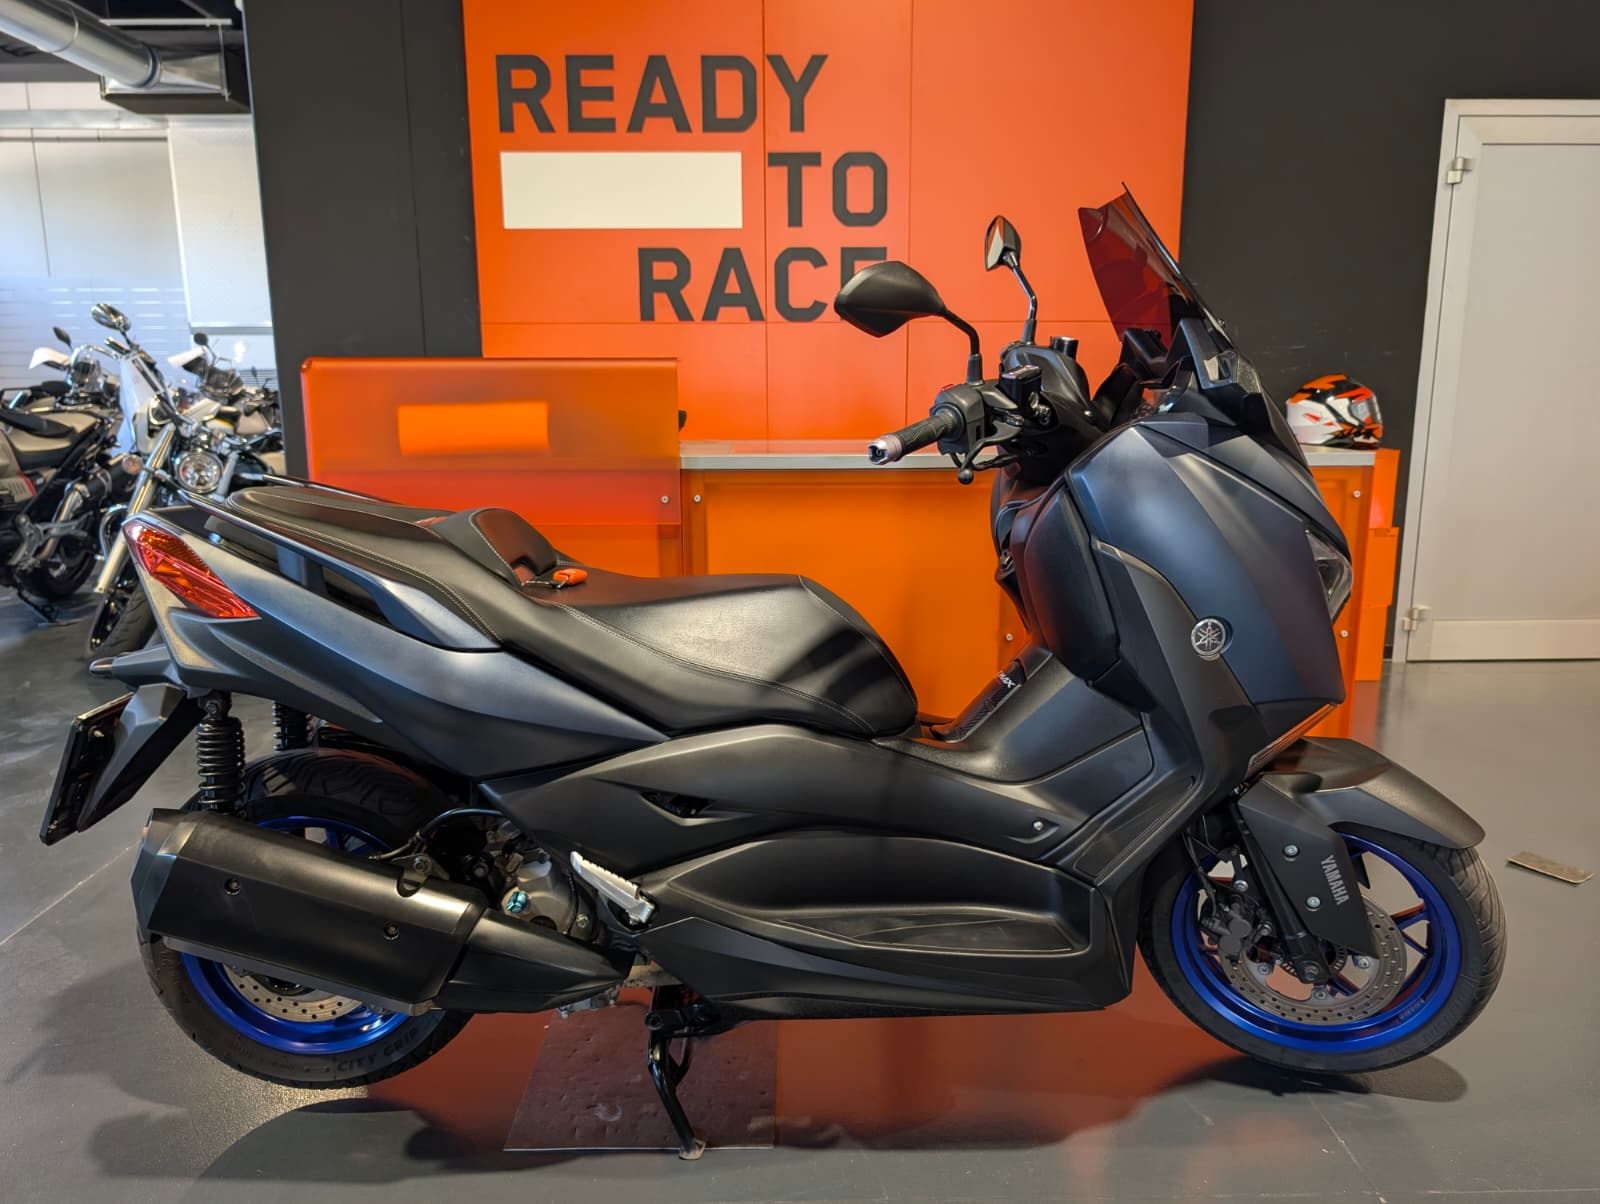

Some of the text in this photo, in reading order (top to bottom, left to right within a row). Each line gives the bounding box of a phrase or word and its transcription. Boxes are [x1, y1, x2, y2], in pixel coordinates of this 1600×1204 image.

[495, 54, 829, 134] READY
[767, 151, 889, 228] TO
[1320, 854, 1350, 905] YAMAHA
[336, 1027, 420, 1073] CITY GRIP
